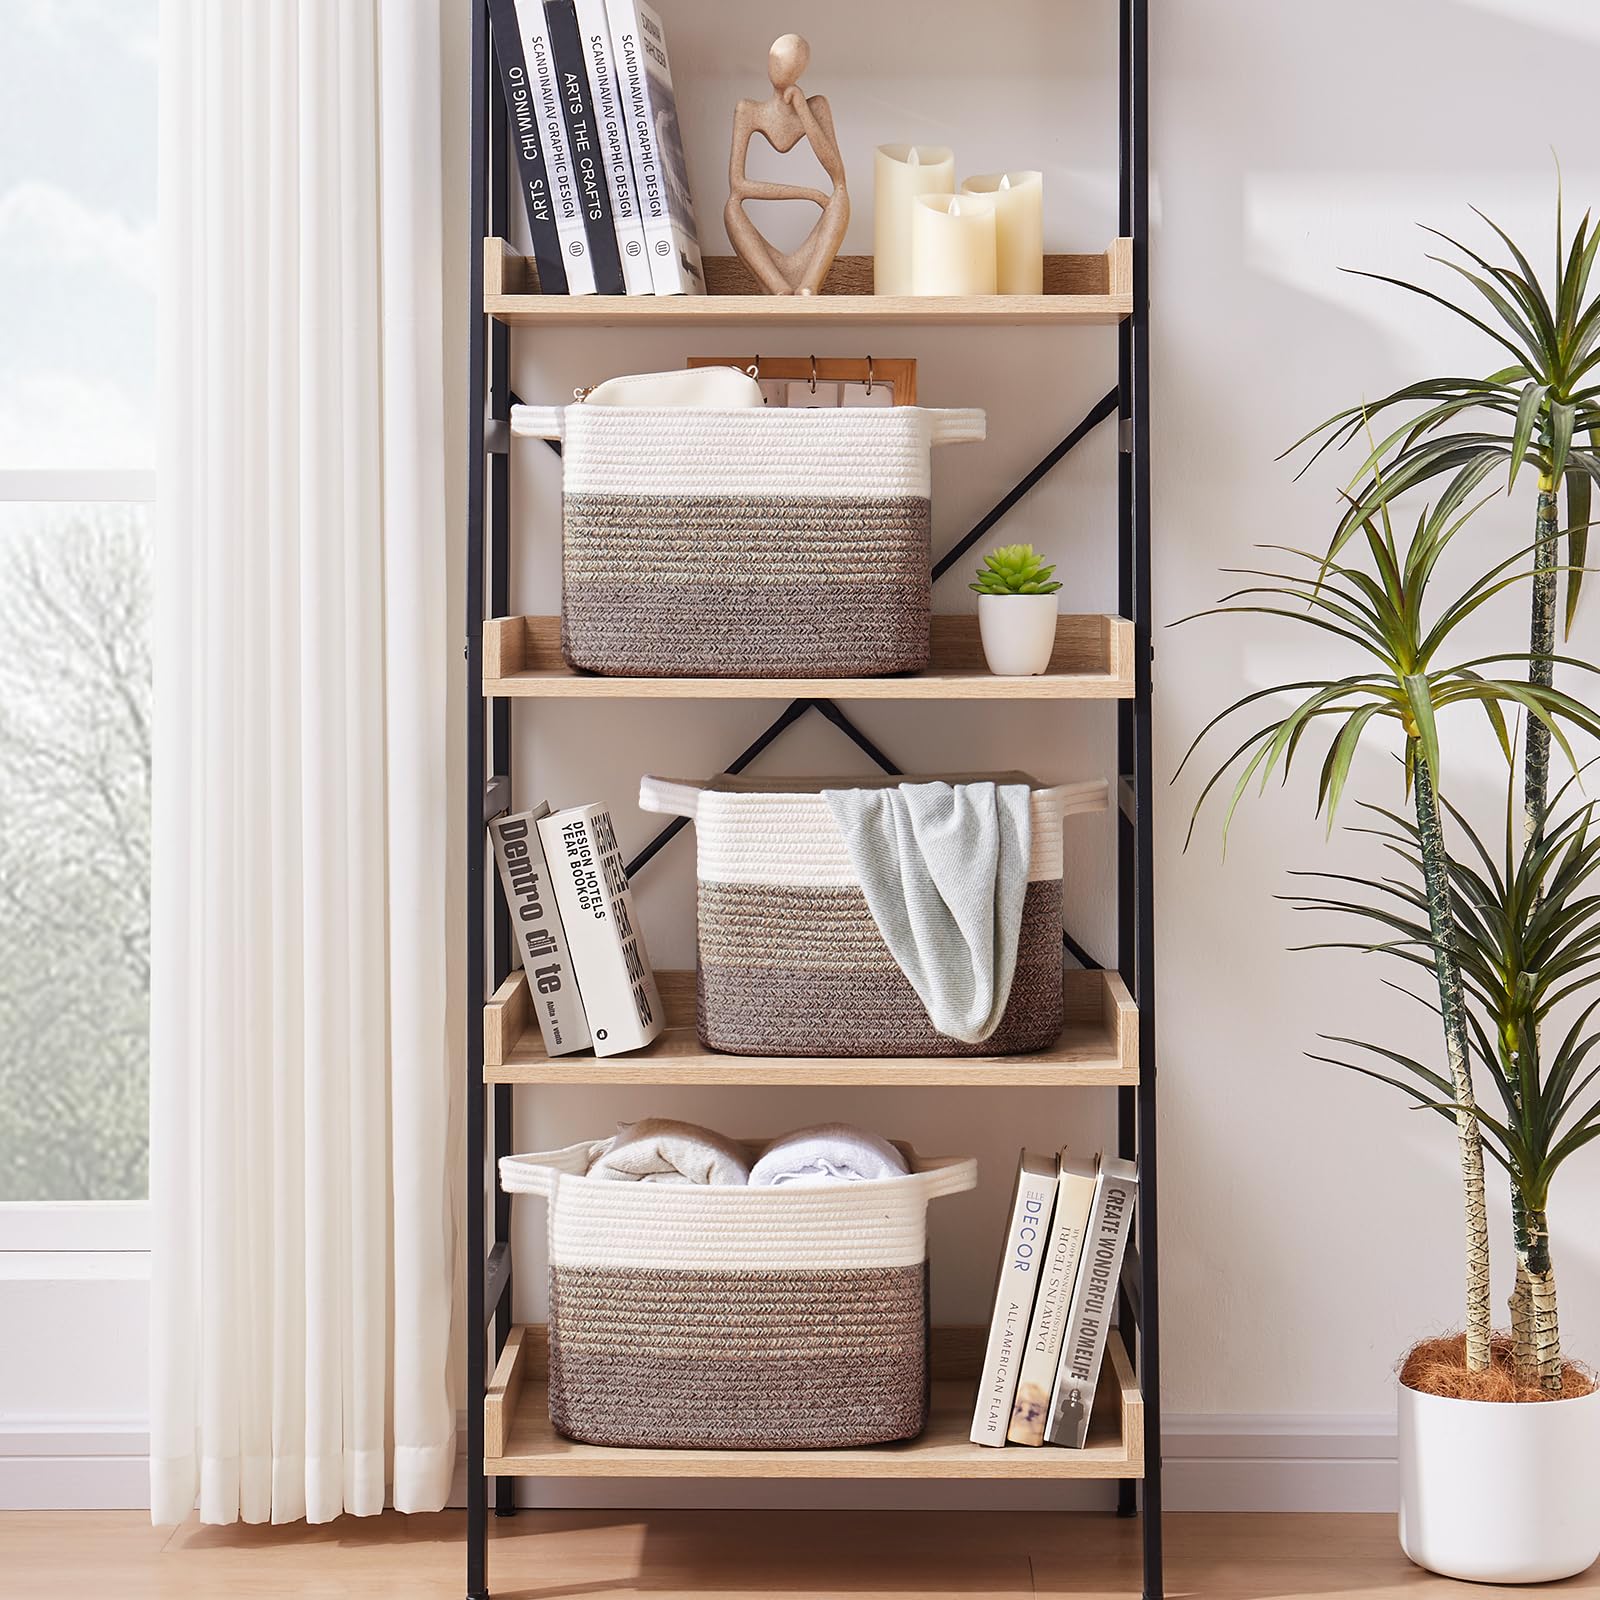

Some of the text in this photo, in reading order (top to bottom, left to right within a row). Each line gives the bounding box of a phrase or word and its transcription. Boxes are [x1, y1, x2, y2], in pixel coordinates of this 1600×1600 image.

[509, 67, 549, 221] ARTS CHI WING LO
[532, 36, 575, 219] SCANDINAVIAV GRAPHIC DESIGN
[564, 73, 602, 220] ARTS THE CRAFTS
[590, 35, 632, 218] SCANDINAVIAV GRAPHIC DESIGN
[622, 34, 662, 217] SCANDINAVIAV GRAPHIC DESIGN
[498, 819, 544, 922] Dentro
[562, 823, 578, 857] YEAR
[573, 821, 593, 867] DESIGN
[585, 871, 606, 919] HOTELS
[525, 928, 558, 958] di
[534, 963, 562, 995] te
[1014, 1200, 1042, 1273] DECOR
[1026, 1191, 1044, 1201] ELLE
[1035, 1226, 1071, 1353] DARWINS TEORI
[1048, 1297, 1064, 1354] EVOLUSJON
[1058, 1259, 1073, 1296] GJENNOM
[1068, 1242, 1077, 1257] 400
[1071, 1188, 1126, 1381] CREATE WONDERFUL HOMELIFE
[987, 1302, 1019, 1433] ALL-AMERICAN FLAIR
